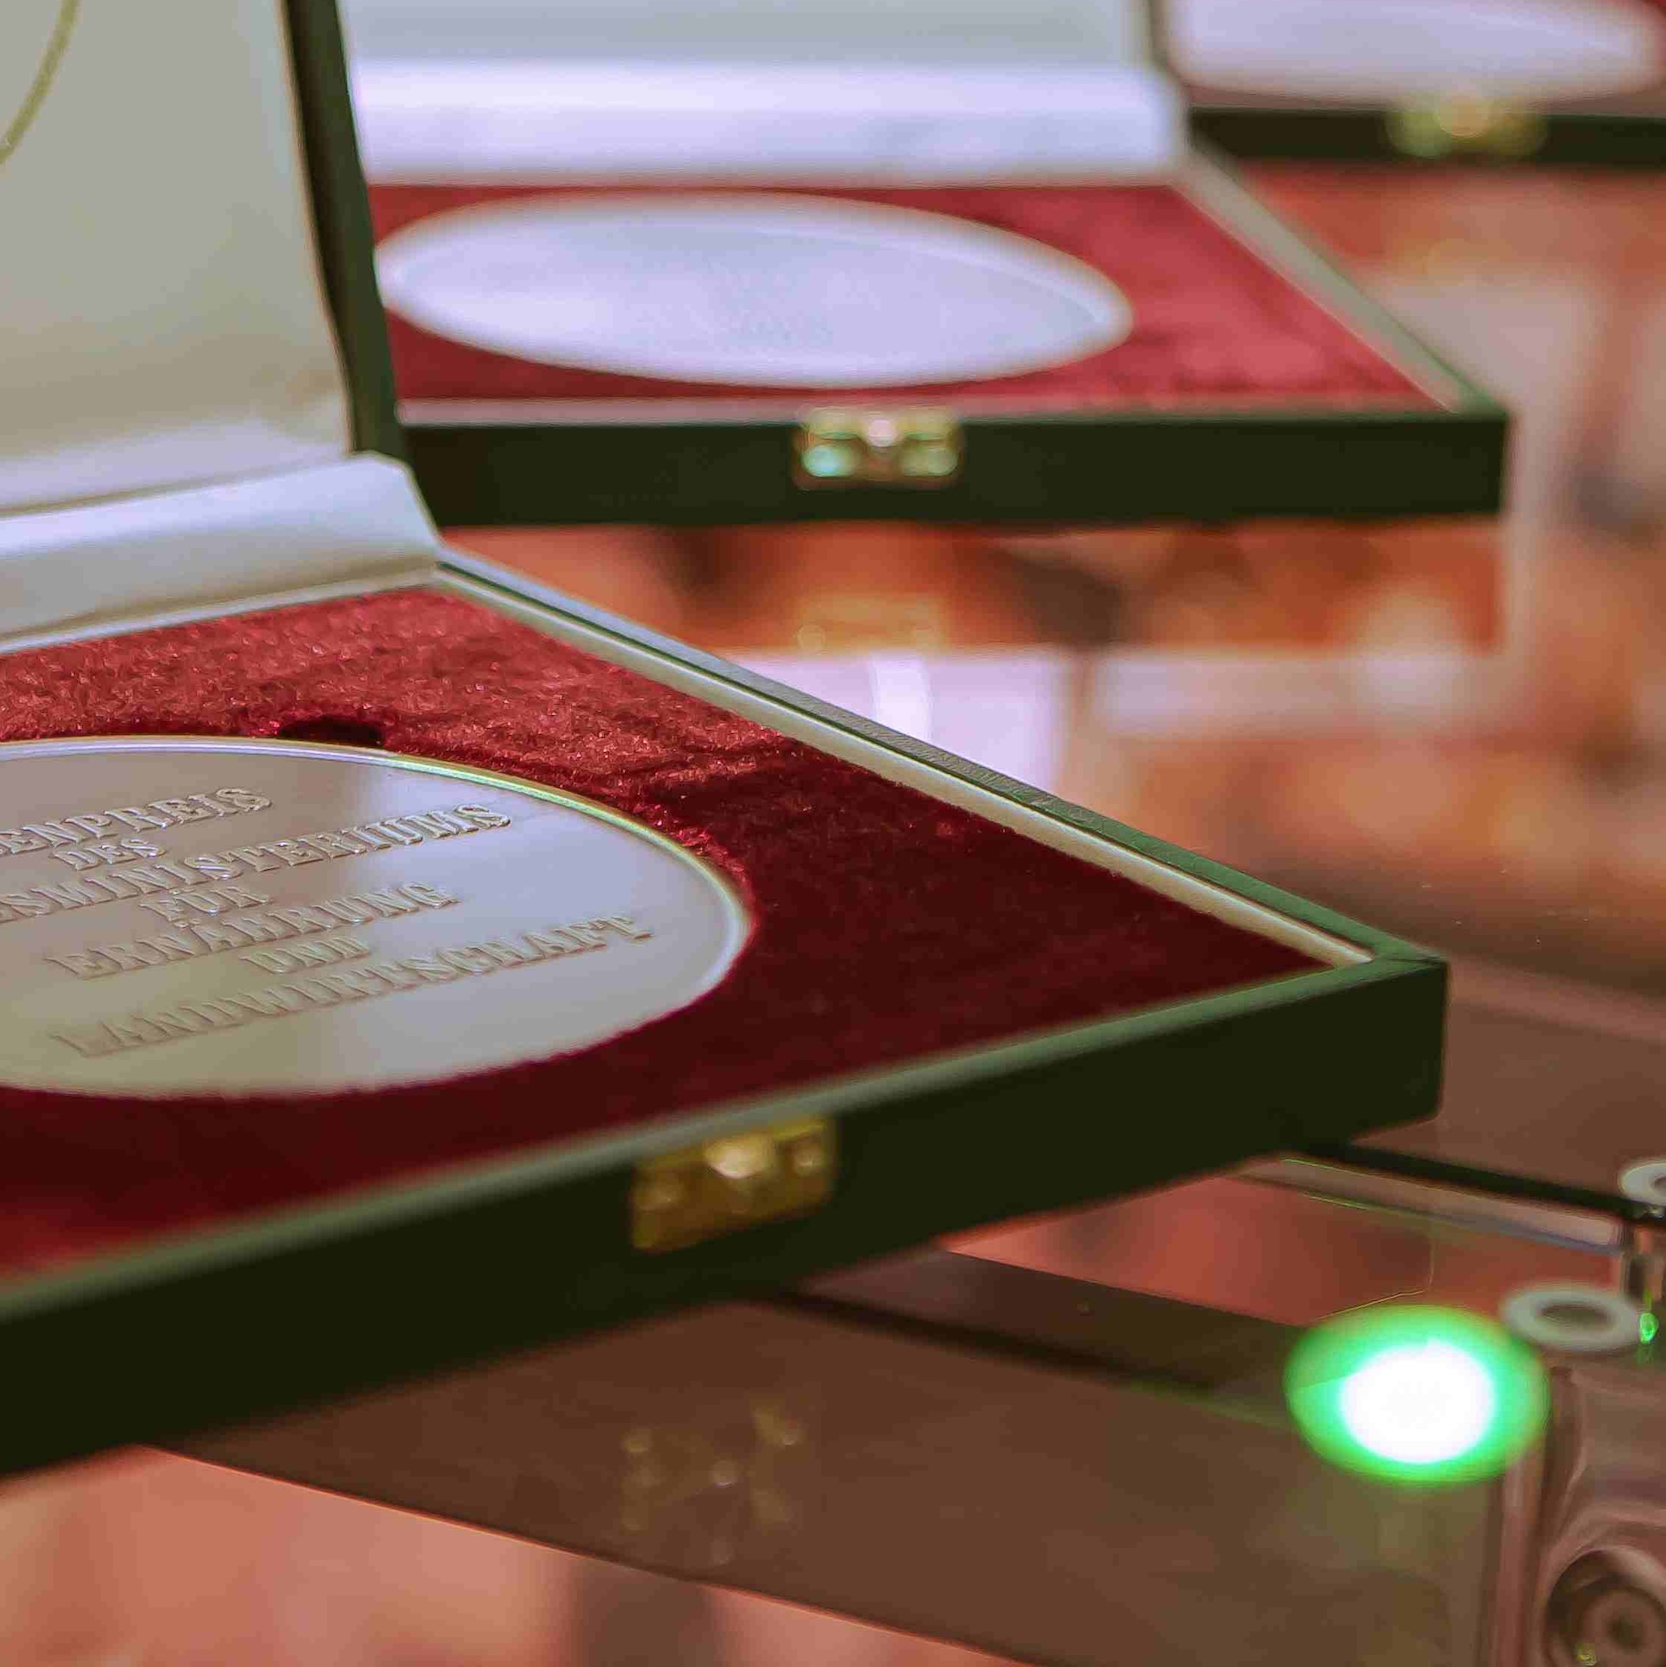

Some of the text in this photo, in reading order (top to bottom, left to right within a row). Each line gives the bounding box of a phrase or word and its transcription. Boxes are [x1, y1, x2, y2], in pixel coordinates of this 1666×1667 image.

[52, 837, 167, 871] DES
[138, 882, 269, 924] FÜR
[45, 882, 461, 978] ERNÄHRUNG
[241, 937, 370, 974] UND
[50, 913, 654, 1056] LANDWIRTSCHAFT
